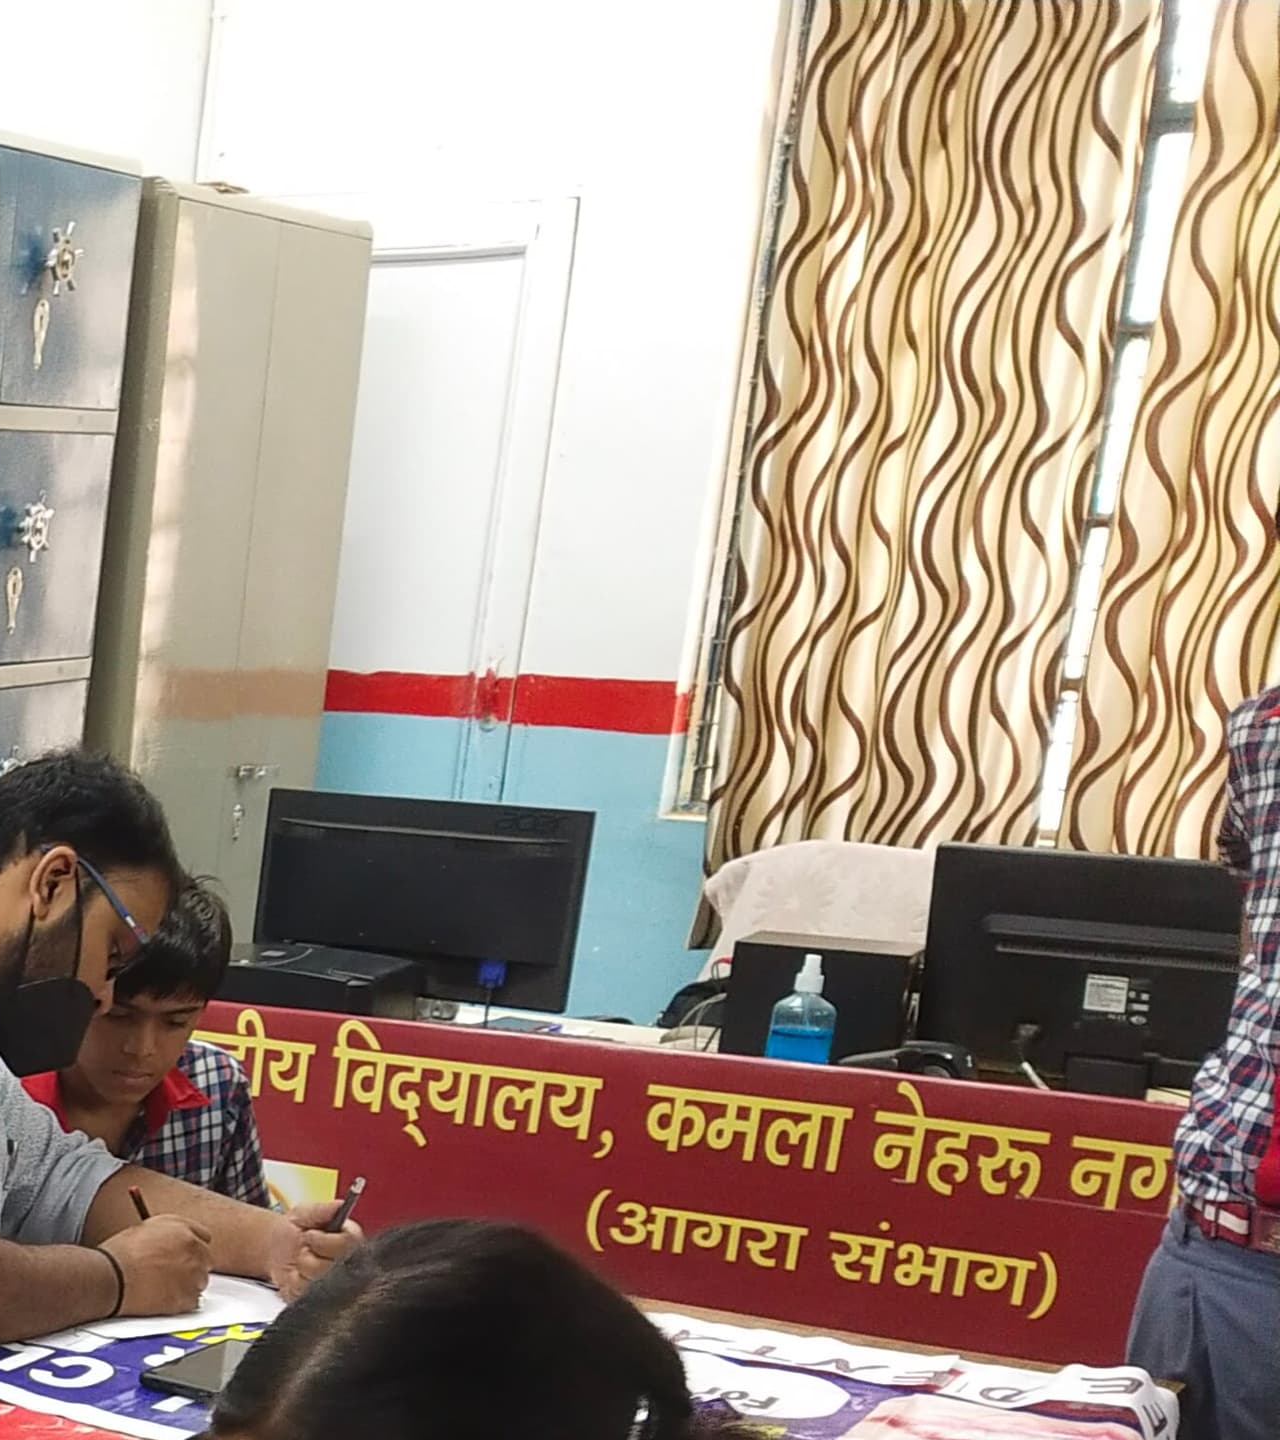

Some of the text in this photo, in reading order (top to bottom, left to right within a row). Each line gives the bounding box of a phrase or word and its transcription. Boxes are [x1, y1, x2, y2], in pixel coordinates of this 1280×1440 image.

[646, 1083, 854, 1173] कमला
[872, 1080, 1051, 1199] नेहरू
[1069, 1134, 1180, 1220] नग
